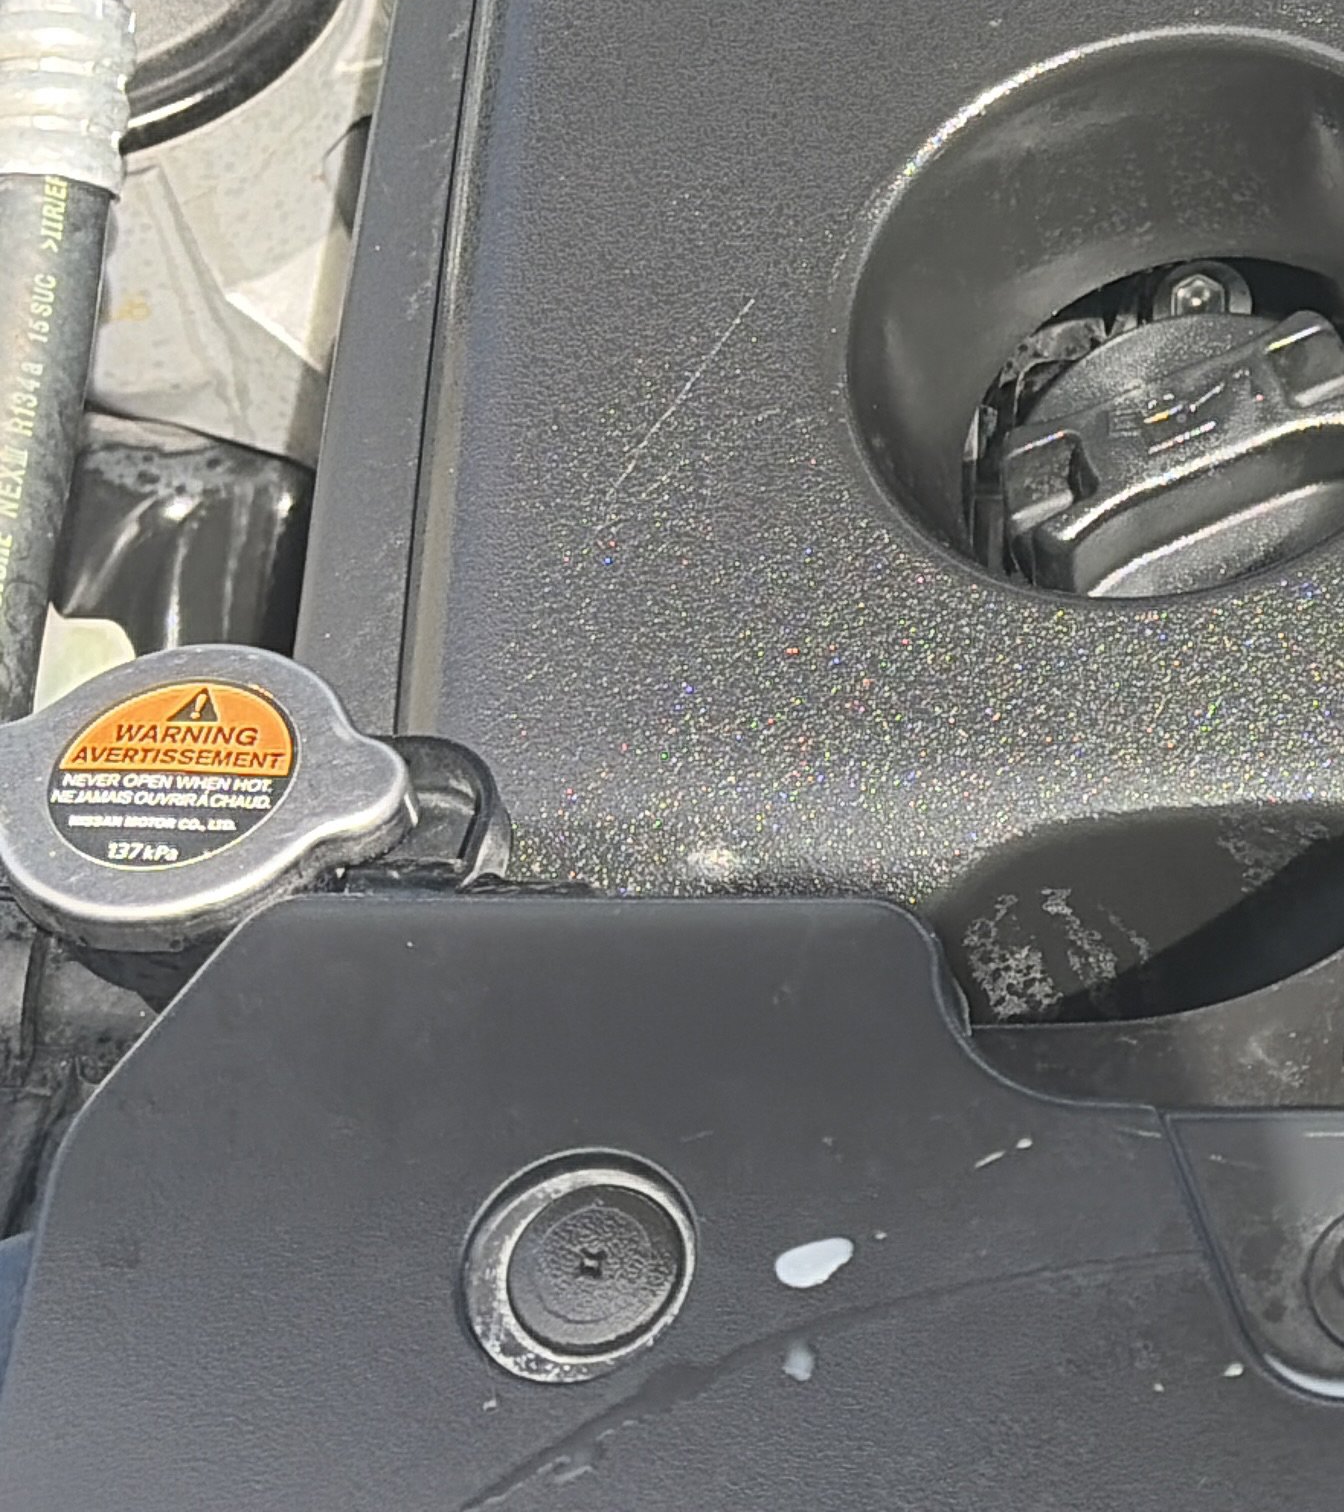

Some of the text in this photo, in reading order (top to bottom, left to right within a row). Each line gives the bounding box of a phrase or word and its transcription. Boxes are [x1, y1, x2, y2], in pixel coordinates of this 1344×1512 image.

[12, 361, 45, 437] R134a
[114, 723, 260, 747] WARNING
[70, 745, 286, 770] AVERTISSEMENT
[62, 772, 274, 794] NEVER OPEN WHEN HOT.
[49, 788, 76, 804] NE
[74, 789, 133, 805] JAMAIS
[133, 790, 197, 807] OUVRIR
[208, 793, 272, 810] CHAUD.
[123, 815, 177, 829] MOTOR
